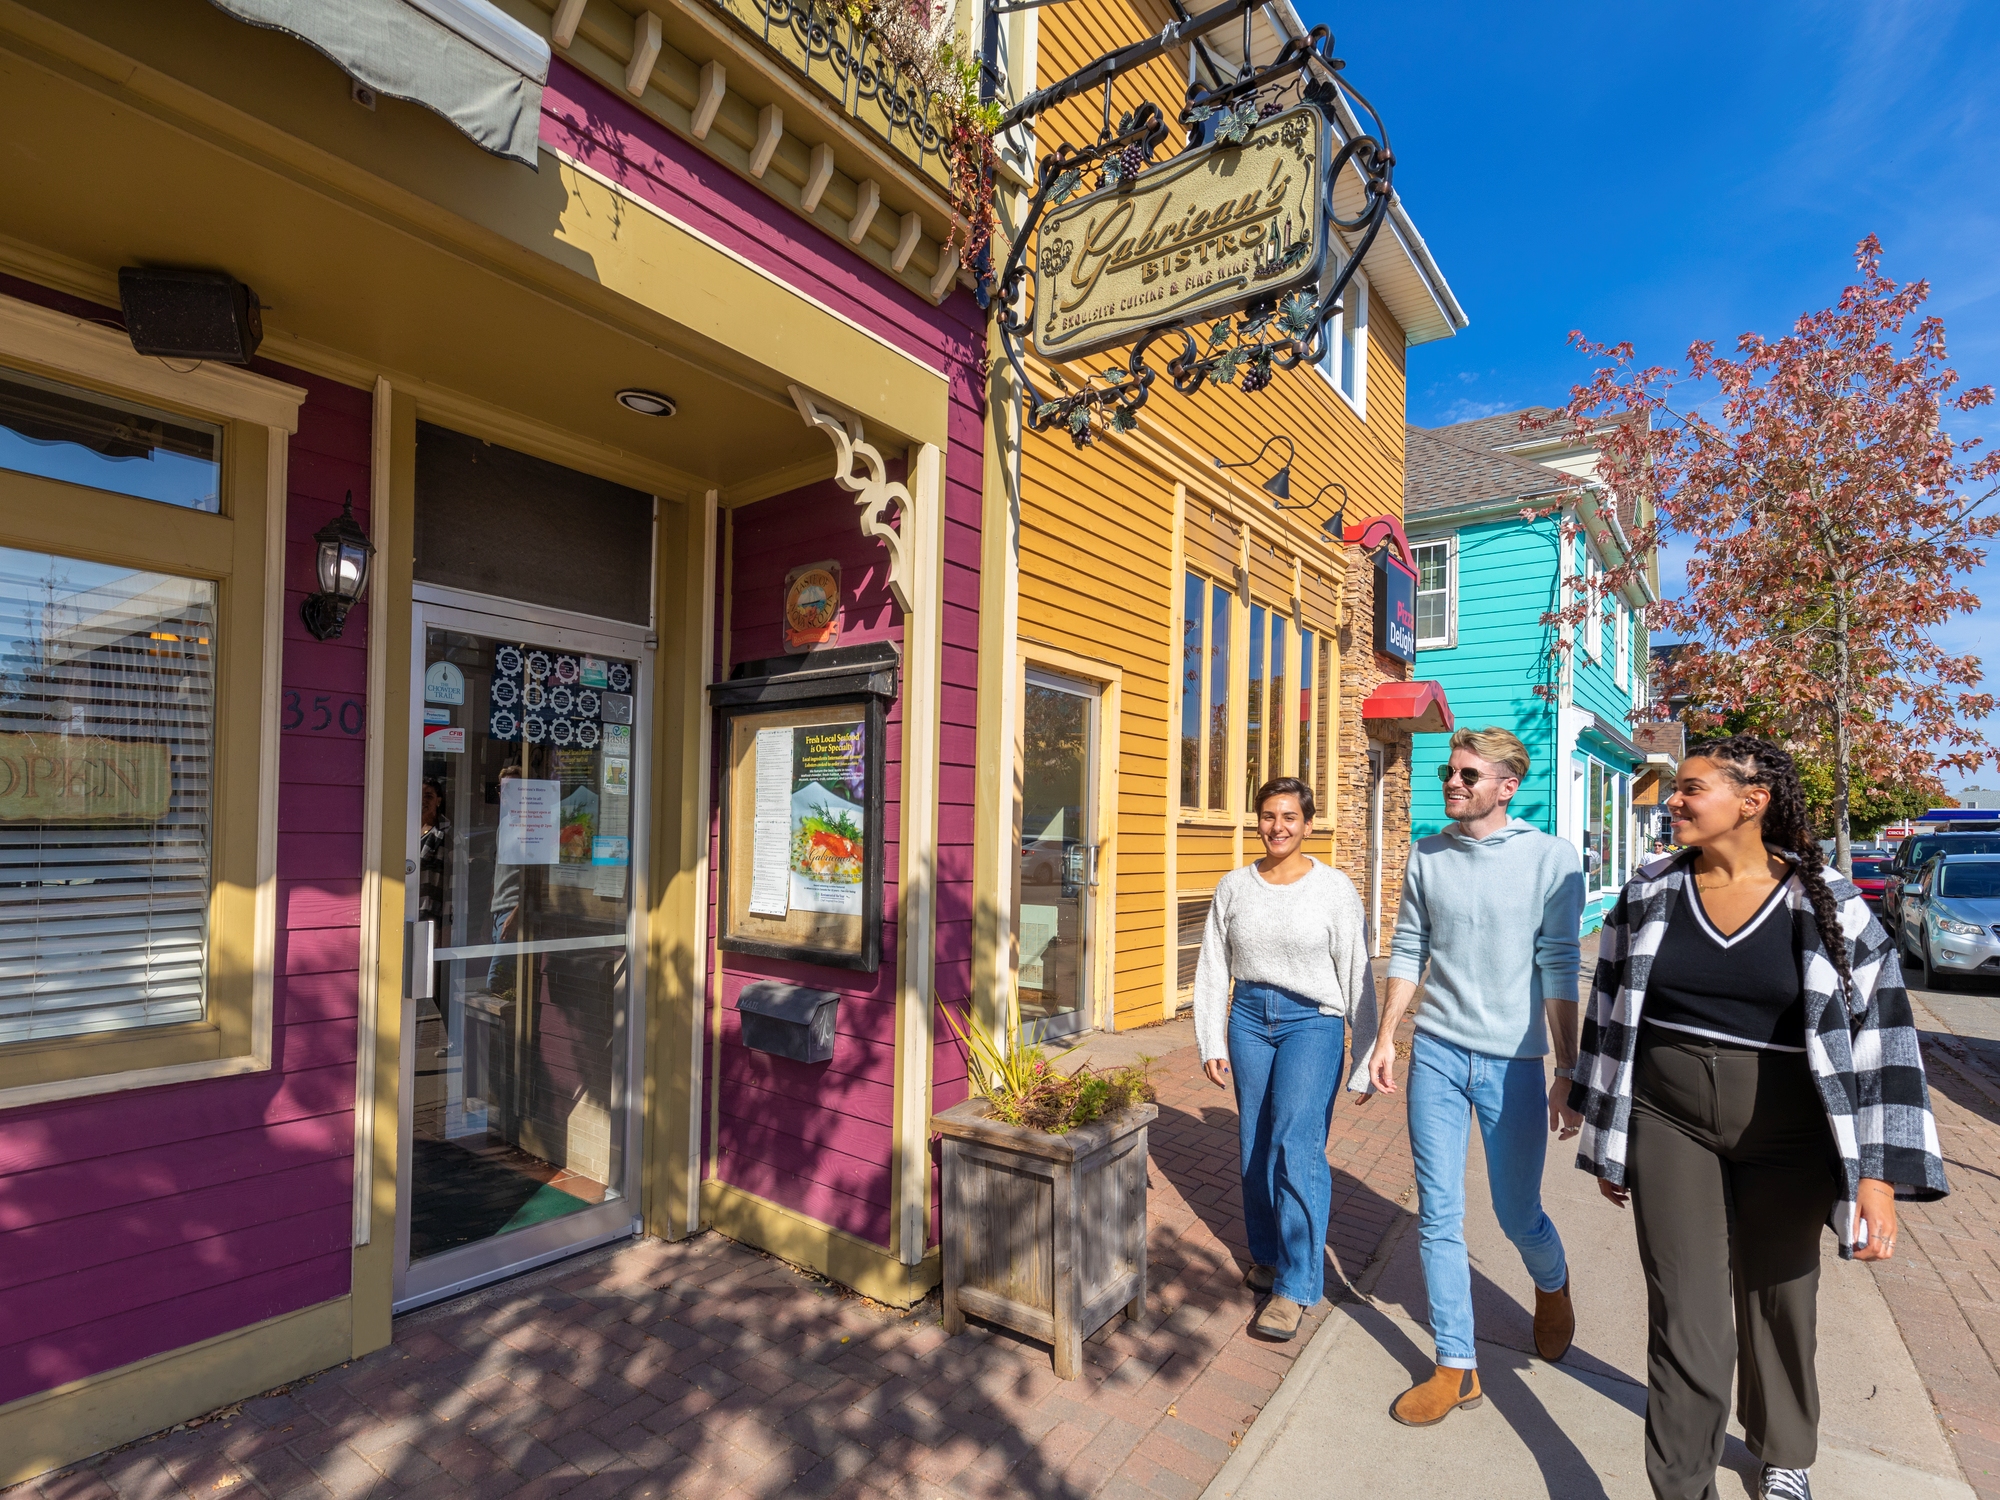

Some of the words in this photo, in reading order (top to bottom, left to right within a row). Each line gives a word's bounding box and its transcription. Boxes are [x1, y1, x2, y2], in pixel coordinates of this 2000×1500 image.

[1059, 157, 1292, 311] Gabrieau's
[1141, 222, 1268, 283] BISTRO
[1062, 303, 1115, 331] EXQUISITE
[1120, 286, 1164, 312] CUISINE
[1169, 282, 1179, 296] &
[1185, 270, 1212, 291] FINE
[1217, 258, 1250, 280] WINE
[795, 573, 819, 594] TASTE
[820, 576, 830, 588] OF
[1397, 600, 1415, 631] Pizza
[1390, 621, 1415, 656] Delight
[427, 684, 461, 695] CHOWDER
[434, 691, 455, 700] TRAIL
[282, 690, 364, 735] 350
[604, 731, 629, 745] Taste
[805, 735, 820, 744] Fresh
[820, 734, 837, 743] Local
[837, 732, 860, 742] Seafood
[810, 745, 815, 753] is
[815, 744, 828, 752] Our
[828, 742, 853, 754] Specialty
[740, 999, 759, 1010] MAIL
